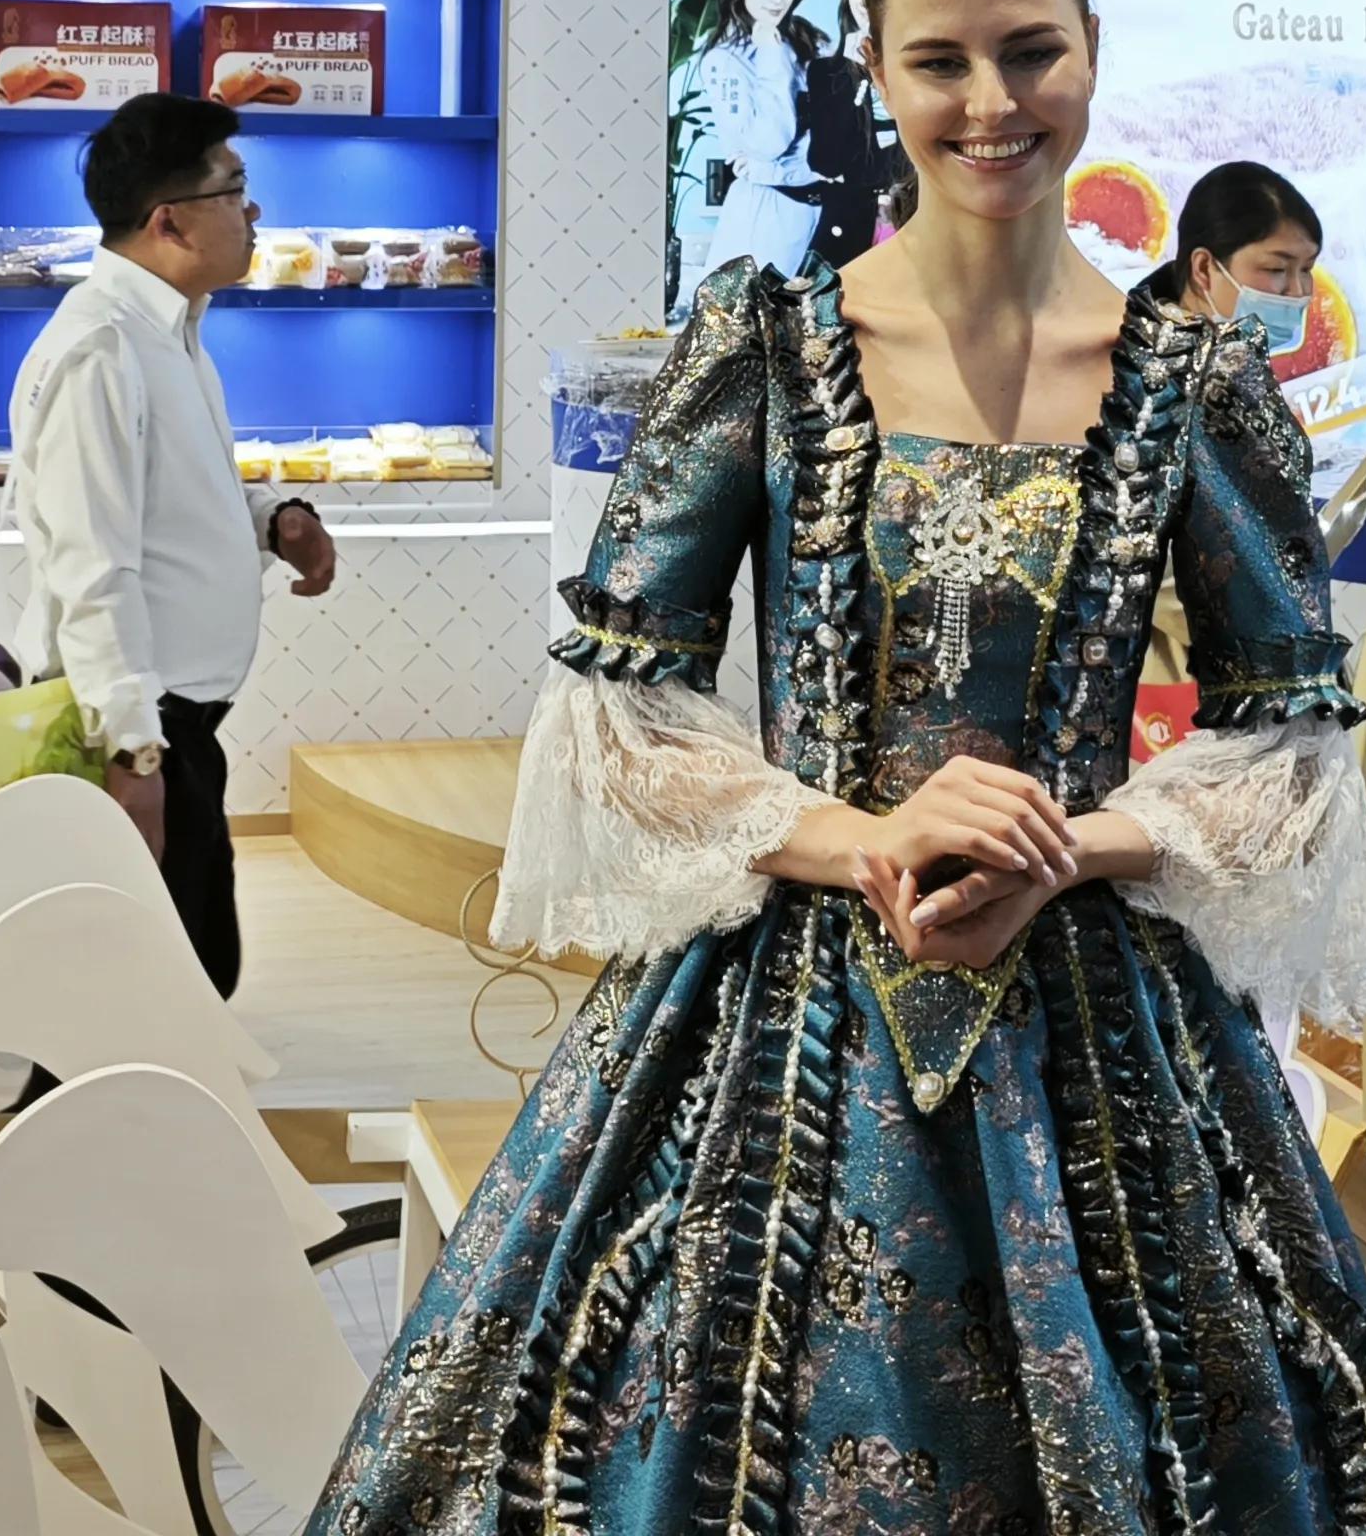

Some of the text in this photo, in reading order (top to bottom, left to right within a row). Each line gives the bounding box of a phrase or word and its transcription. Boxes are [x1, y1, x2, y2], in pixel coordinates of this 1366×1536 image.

[1233, 2, 1344, 41] Gateau
[56, 25, 143, 46] 红豆起酥
[273, 30, 358, 52] 红豆起酥
[70, 55, 155, 67] PUFF BREAD
[286, 61, 368, 72] PUFF BREAD
